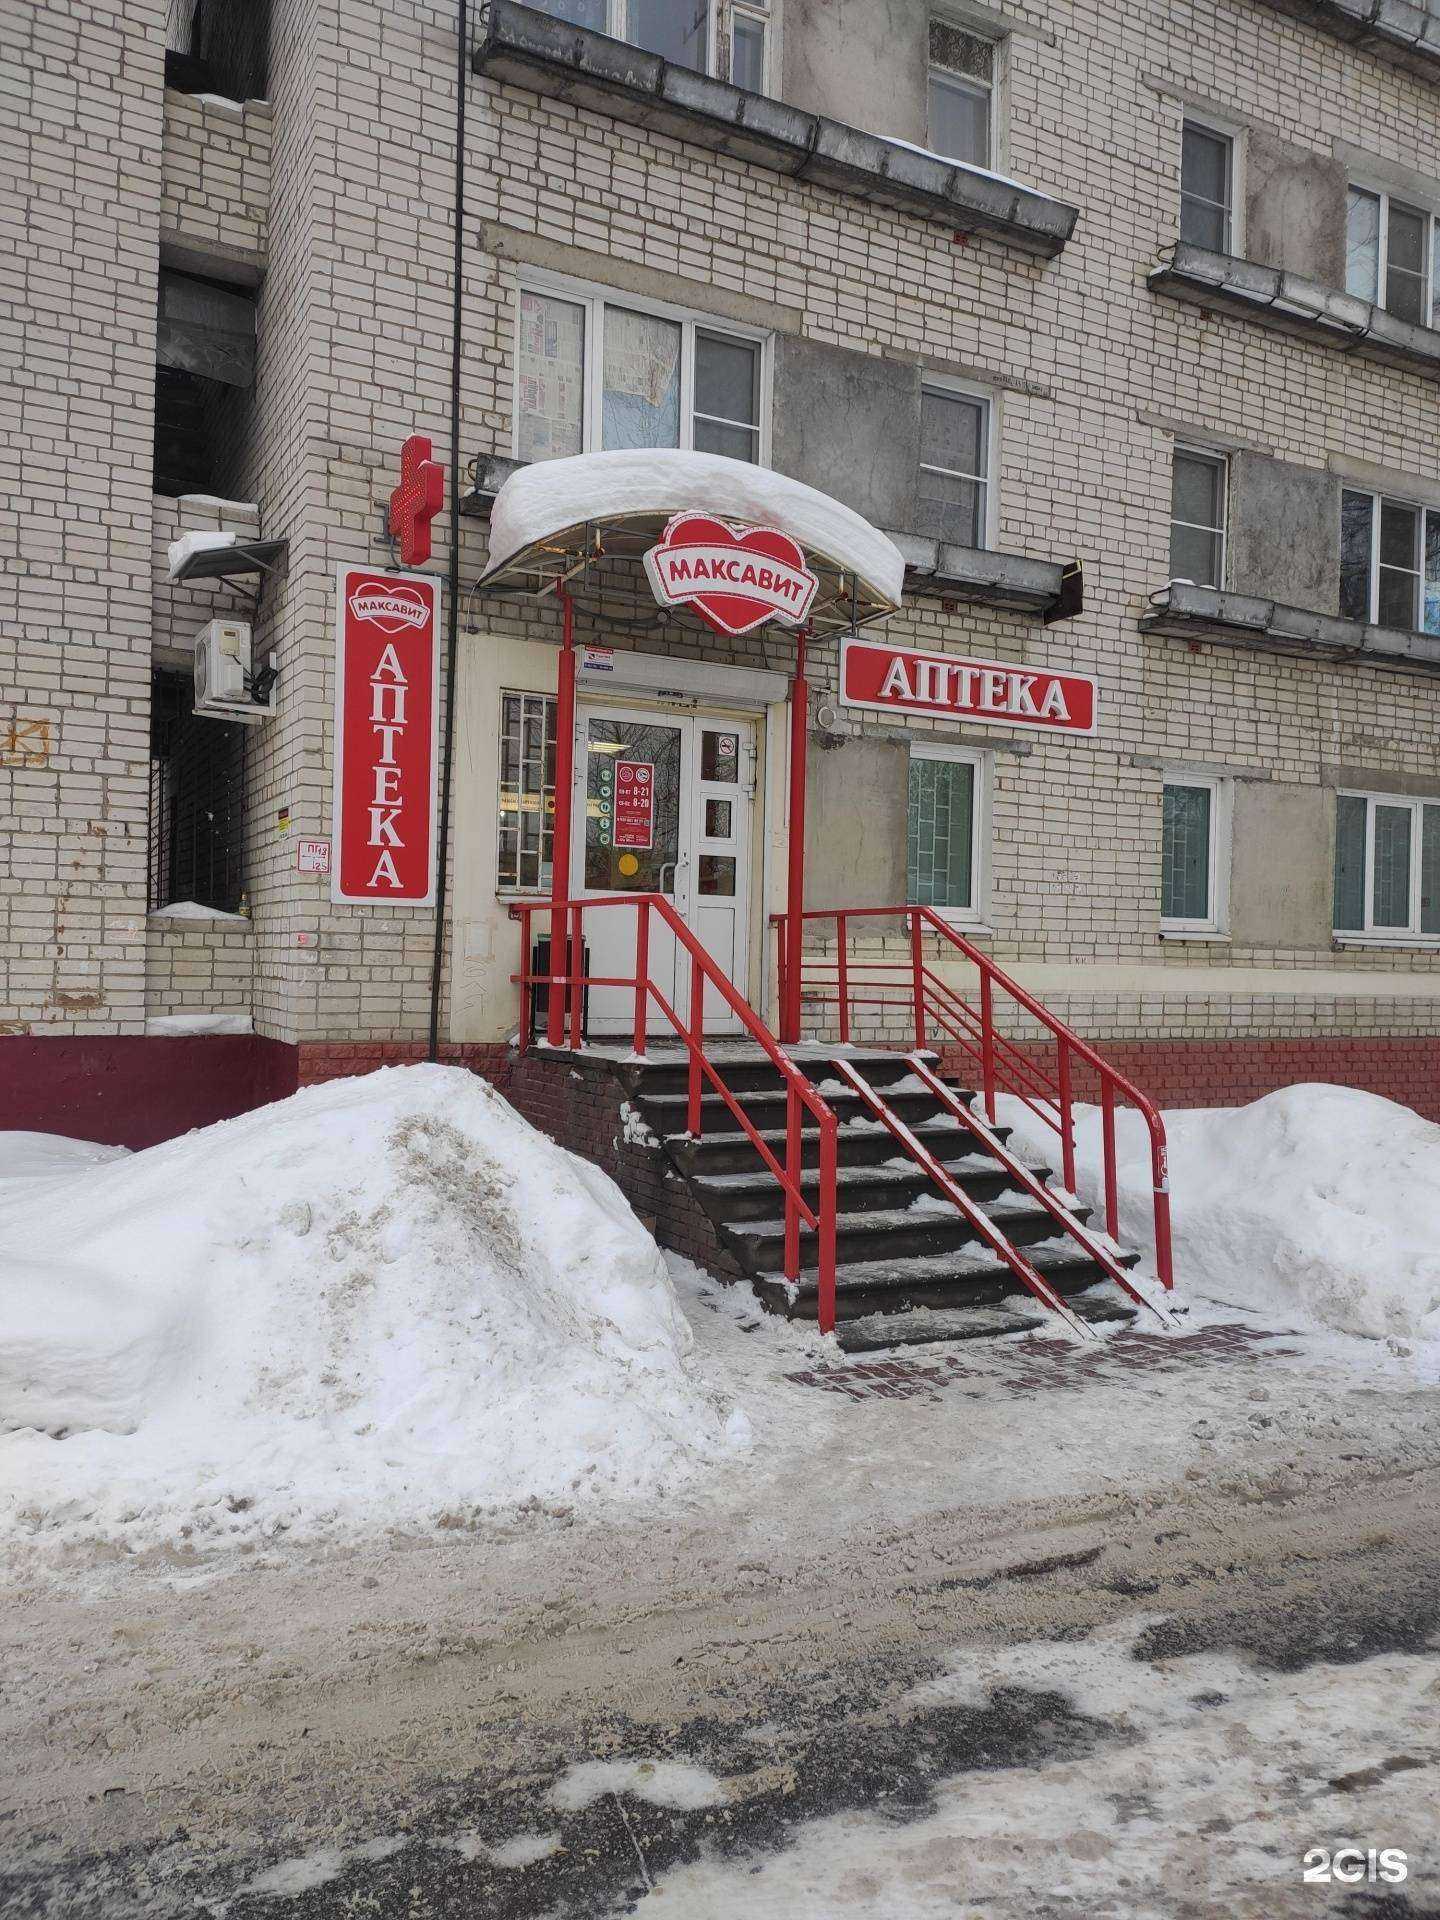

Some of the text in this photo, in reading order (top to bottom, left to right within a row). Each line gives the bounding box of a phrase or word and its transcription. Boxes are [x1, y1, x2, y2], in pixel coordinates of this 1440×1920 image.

[668, 558, 805, 603] МАКСАВИТ
[357, 600, 424, 620] МАКСАВИТ
[878, 656, 1072, 721] АПТЕКА
[366, 643, 409, 889] АПТЕКА
[633, 786, 650, 797] 8-21
[633, 797, 650, 808] 8-20
